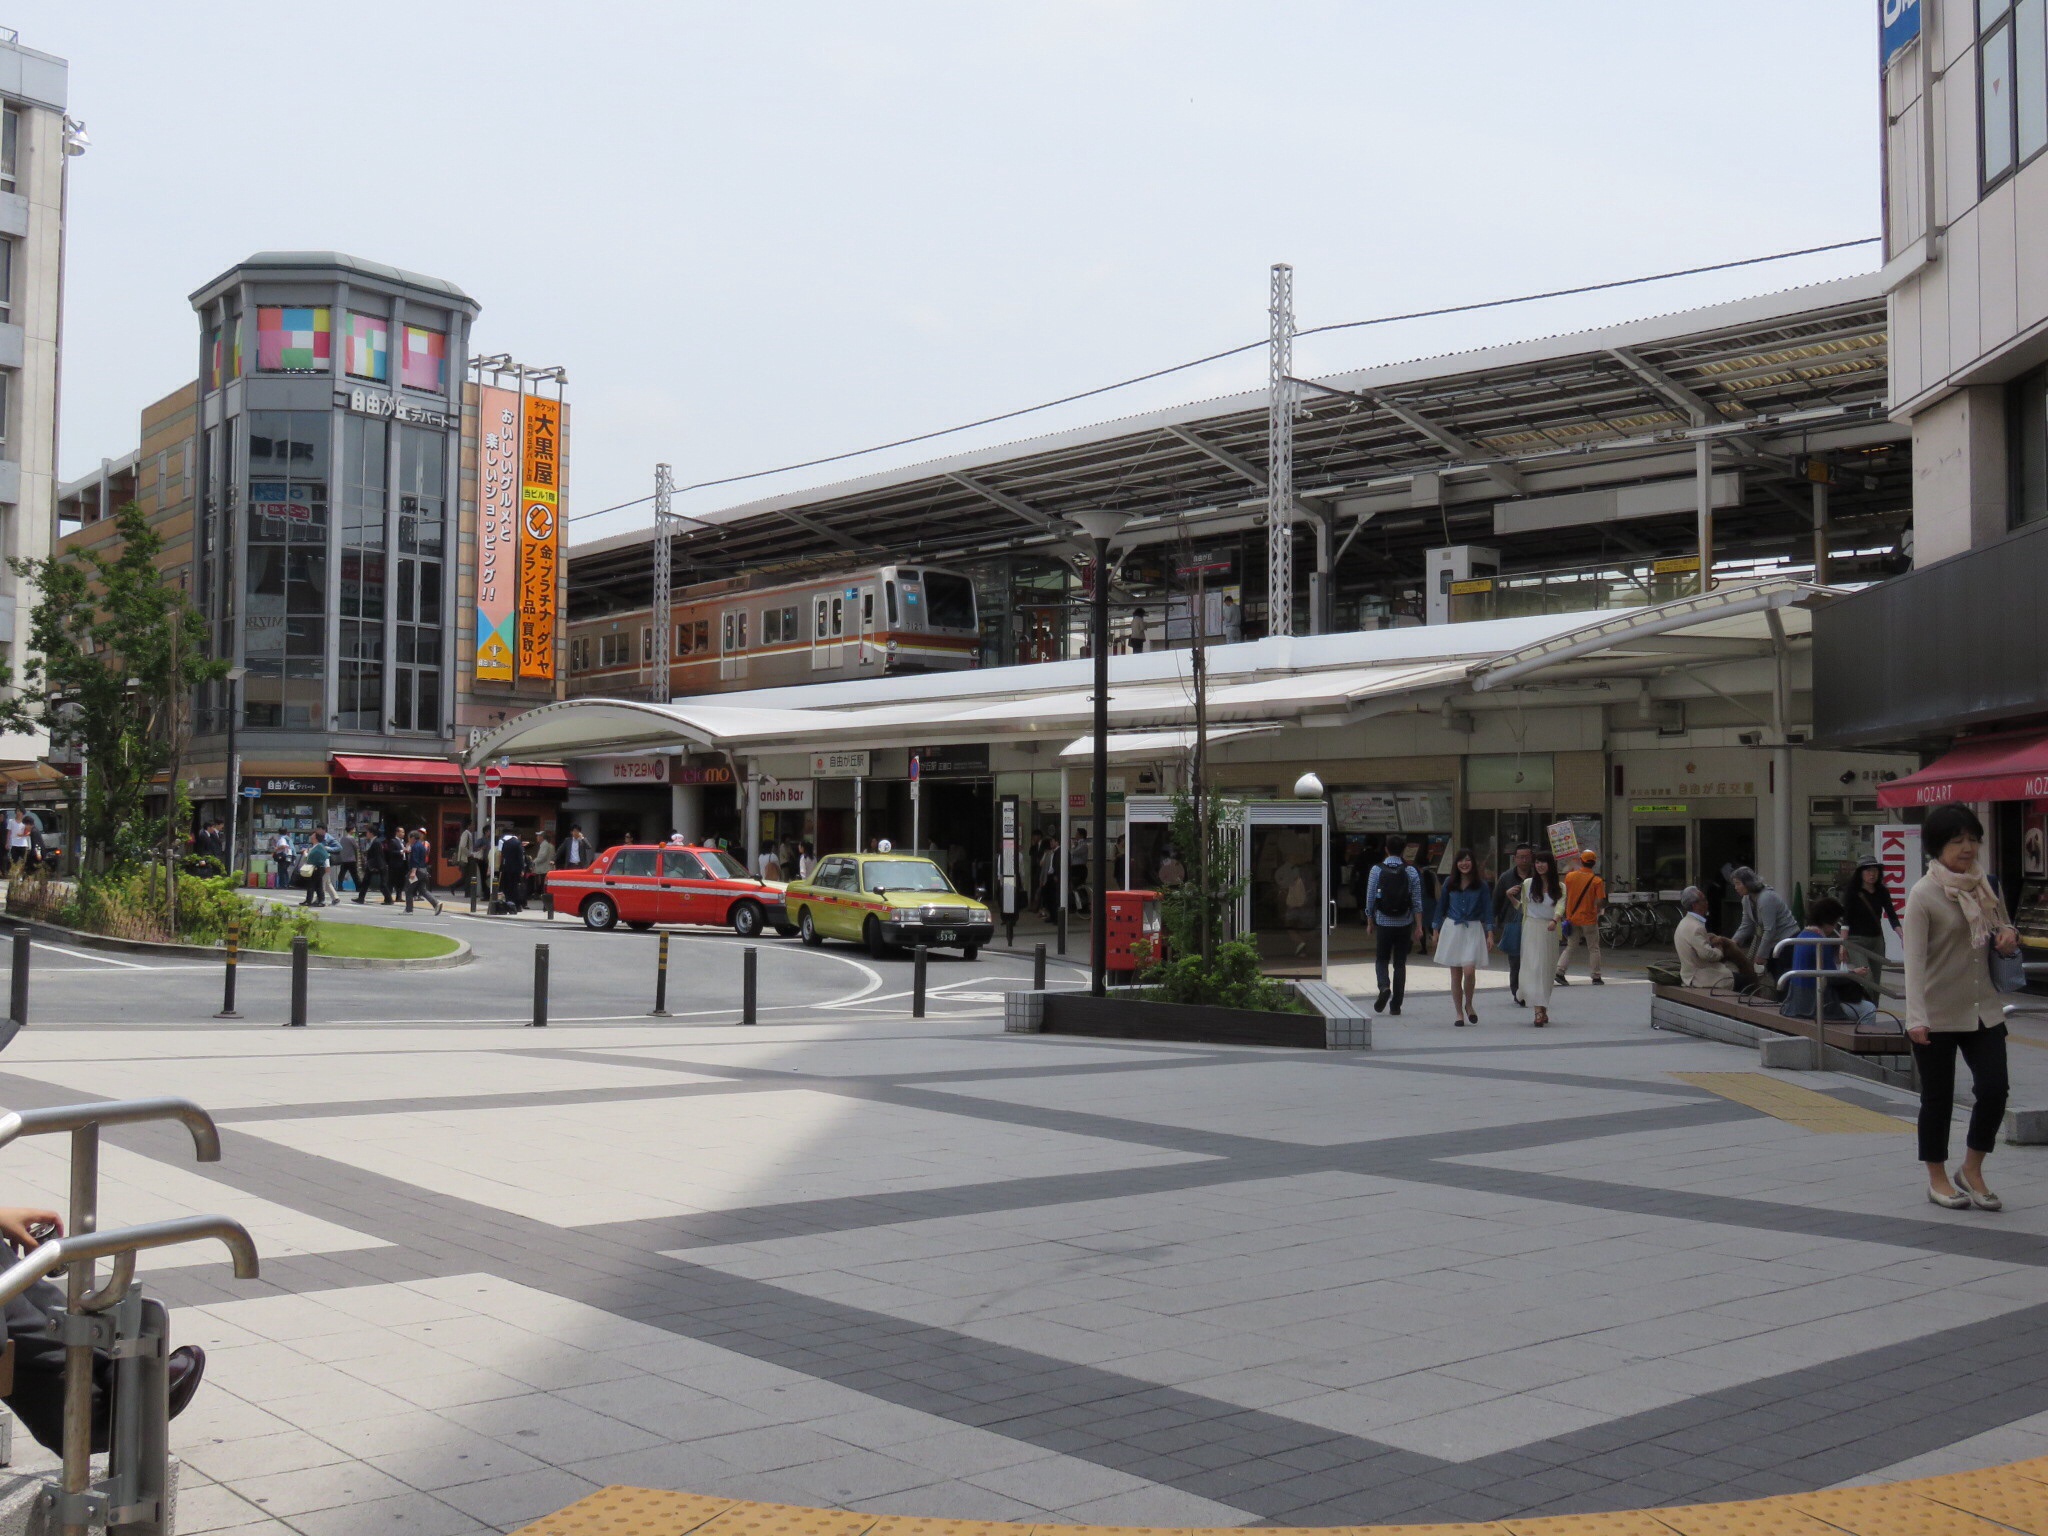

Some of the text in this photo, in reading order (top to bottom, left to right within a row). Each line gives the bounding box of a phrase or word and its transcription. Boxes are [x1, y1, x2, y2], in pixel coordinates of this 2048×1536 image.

[351, 388, 449, 428] 自由が丘デパート
[534, 401, 556, 412] チケット
[533, 413, 554, 486] 大黒屋
[500, 408, 514, 542] おいしいグルメと
[829, 755, 864, 768] 自由が丘駅
[748, 788, 804, 801] anish Bar
[1917, 784, 1952, 803] MOZART
[1882, 830, 1906, 919] KIRIN
